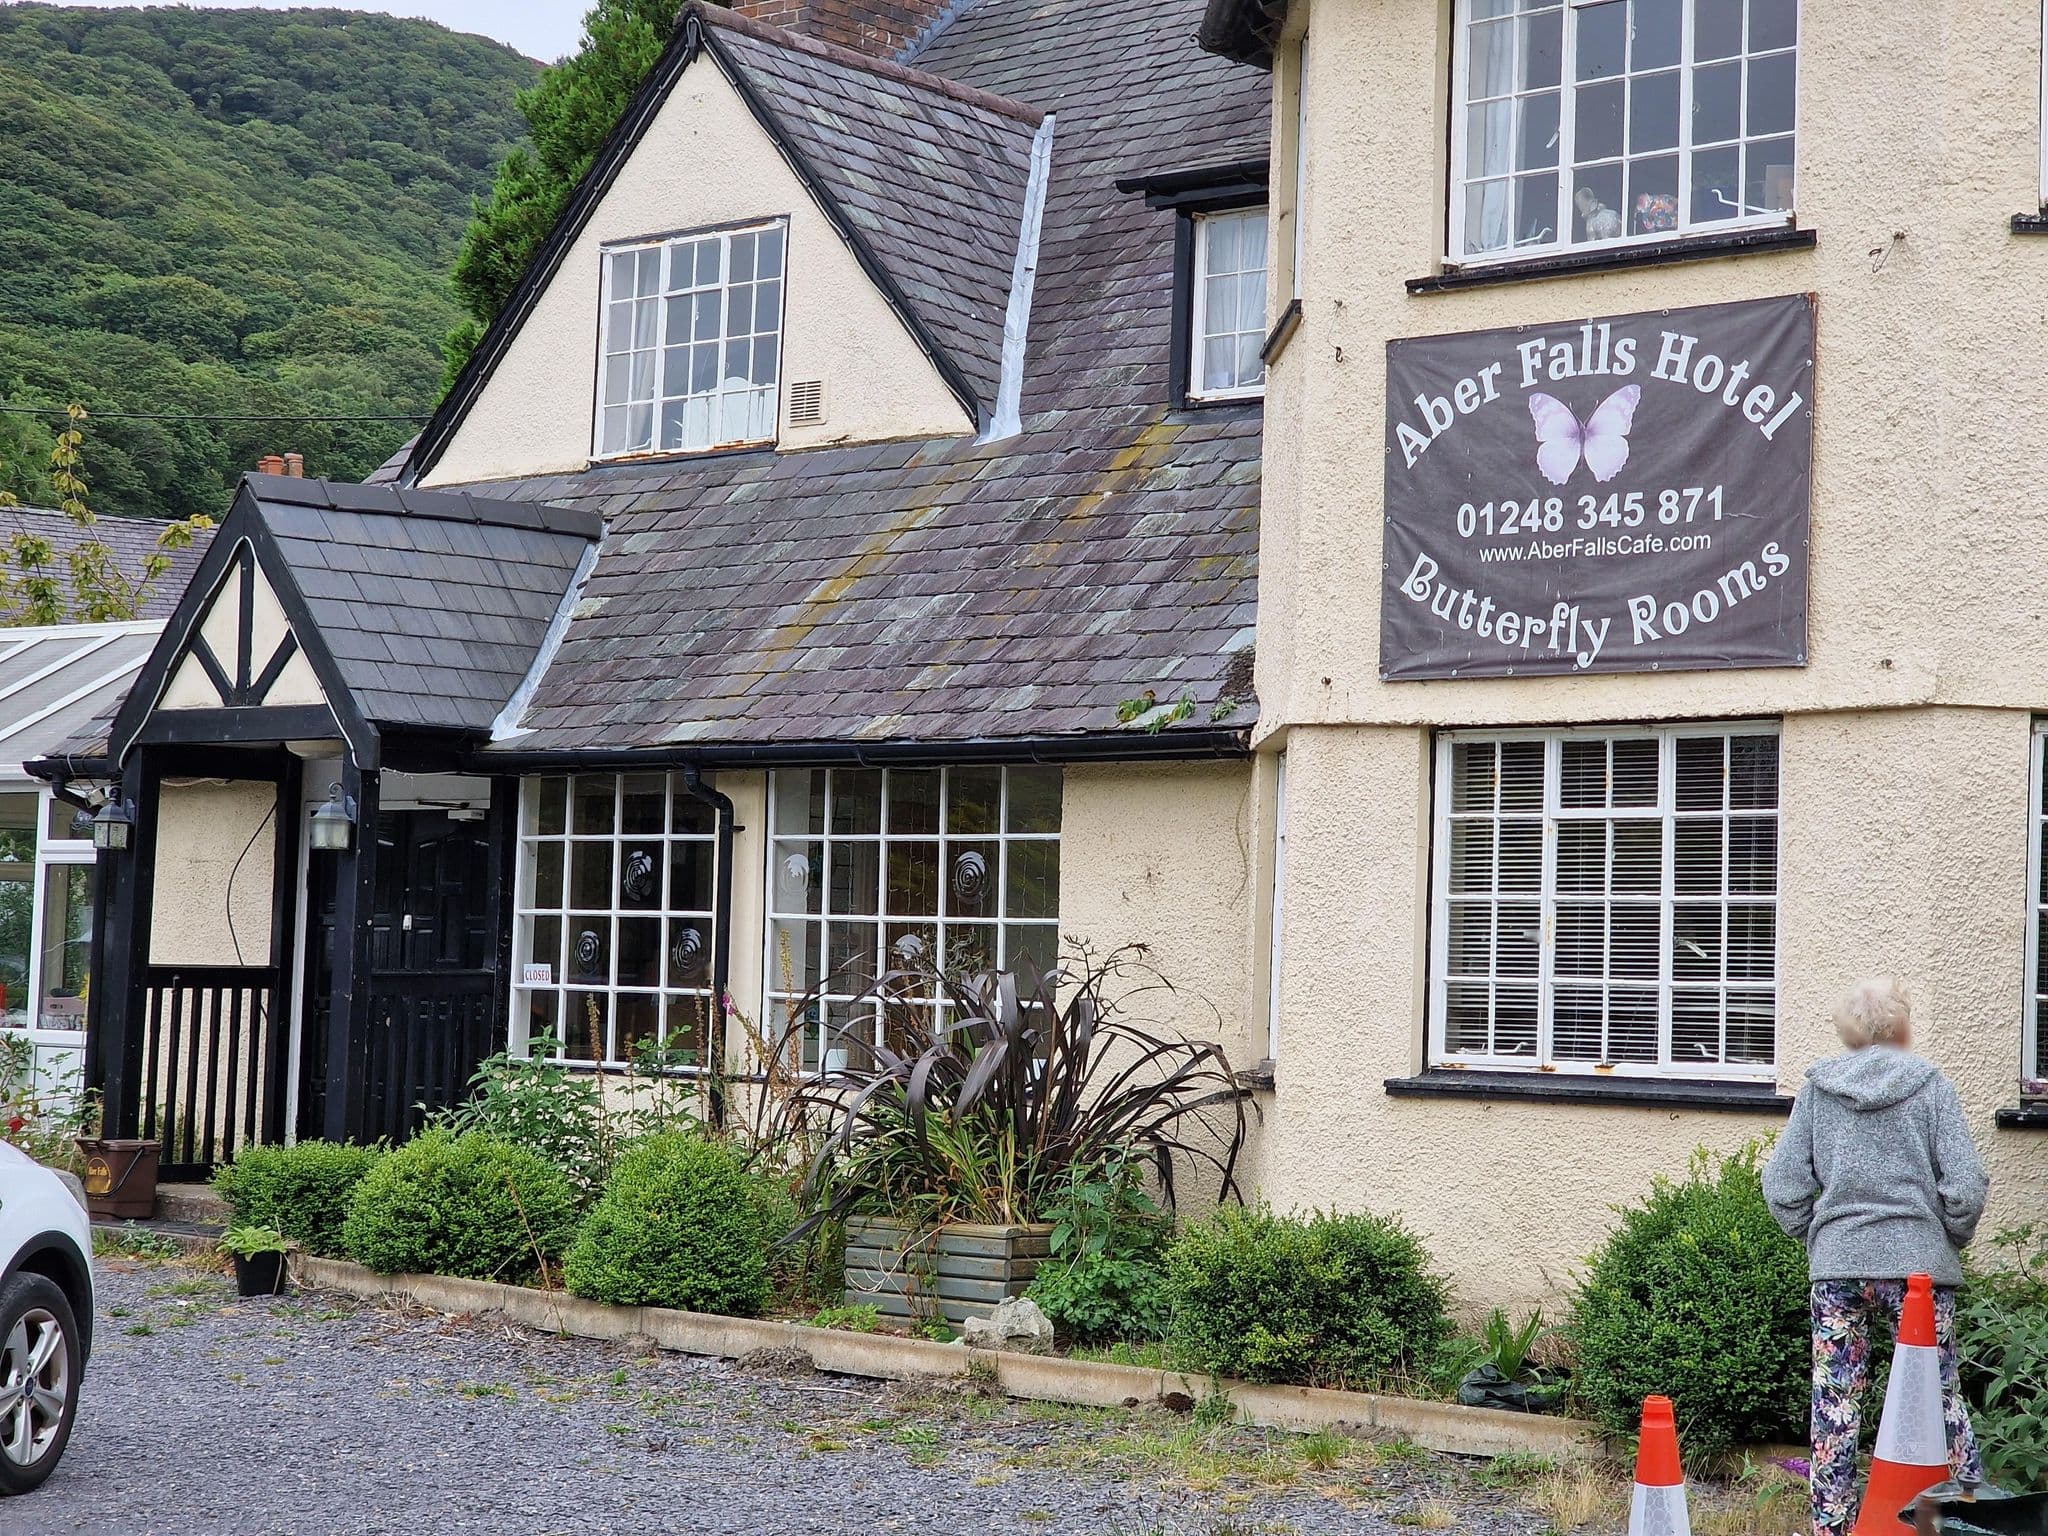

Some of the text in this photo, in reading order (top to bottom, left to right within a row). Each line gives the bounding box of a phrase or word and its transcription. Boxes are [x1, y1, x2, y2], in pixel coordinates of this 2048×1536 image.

[1394, 323, 1803, 470] Aber Falls Hotel
[1456, 484, 1724, 538] 01248 345 871
[1478, 532, 1712, 563] www.AberFallsCafe.com
[1400, 541, 1791, 669] Butterfly Rooms
[525, 970, 550, 981] CLOSED
